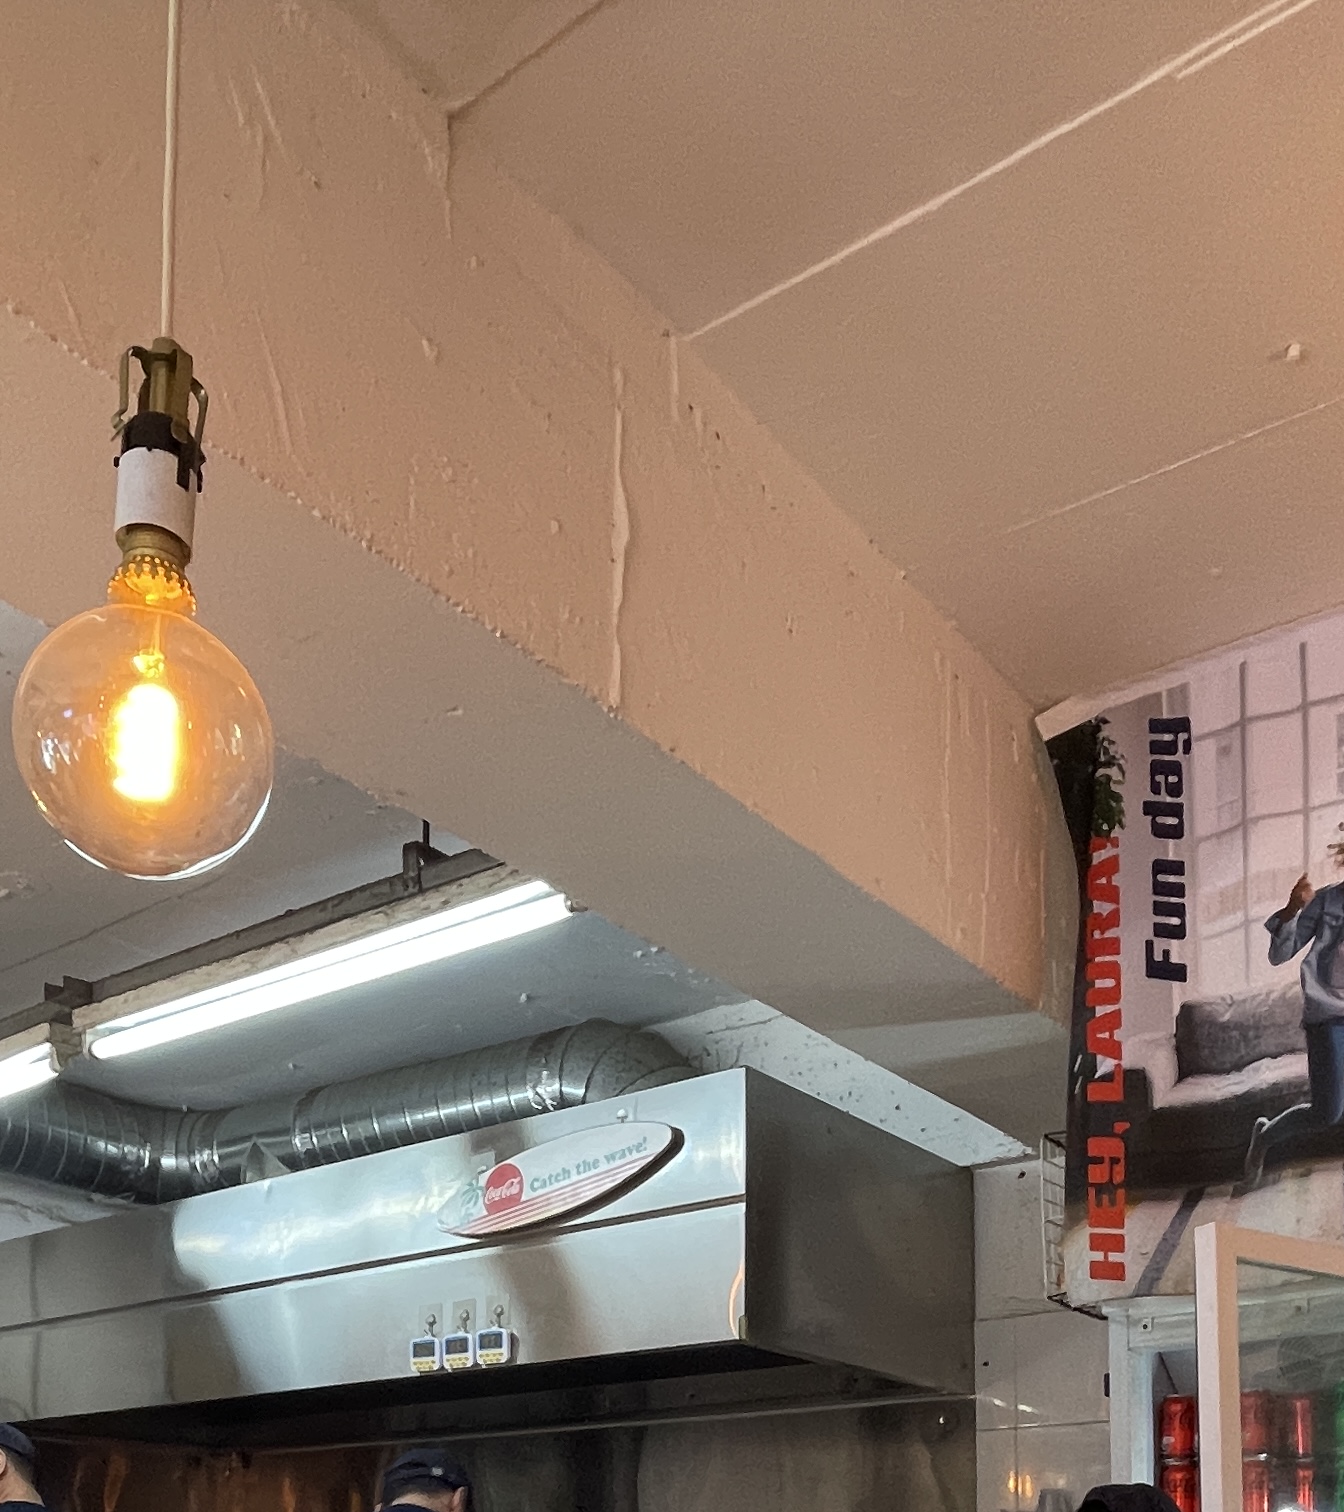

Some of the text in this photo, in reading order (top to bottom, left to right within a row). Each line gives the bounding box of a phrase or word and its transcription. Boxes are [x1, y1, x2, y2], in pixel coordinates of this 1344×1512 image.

[1143, 716, 1192, 983] Fun day
[529, 1136, 648, 1193] Catch the wave!
[1088, 1121, 1131, 1281] HEY,
